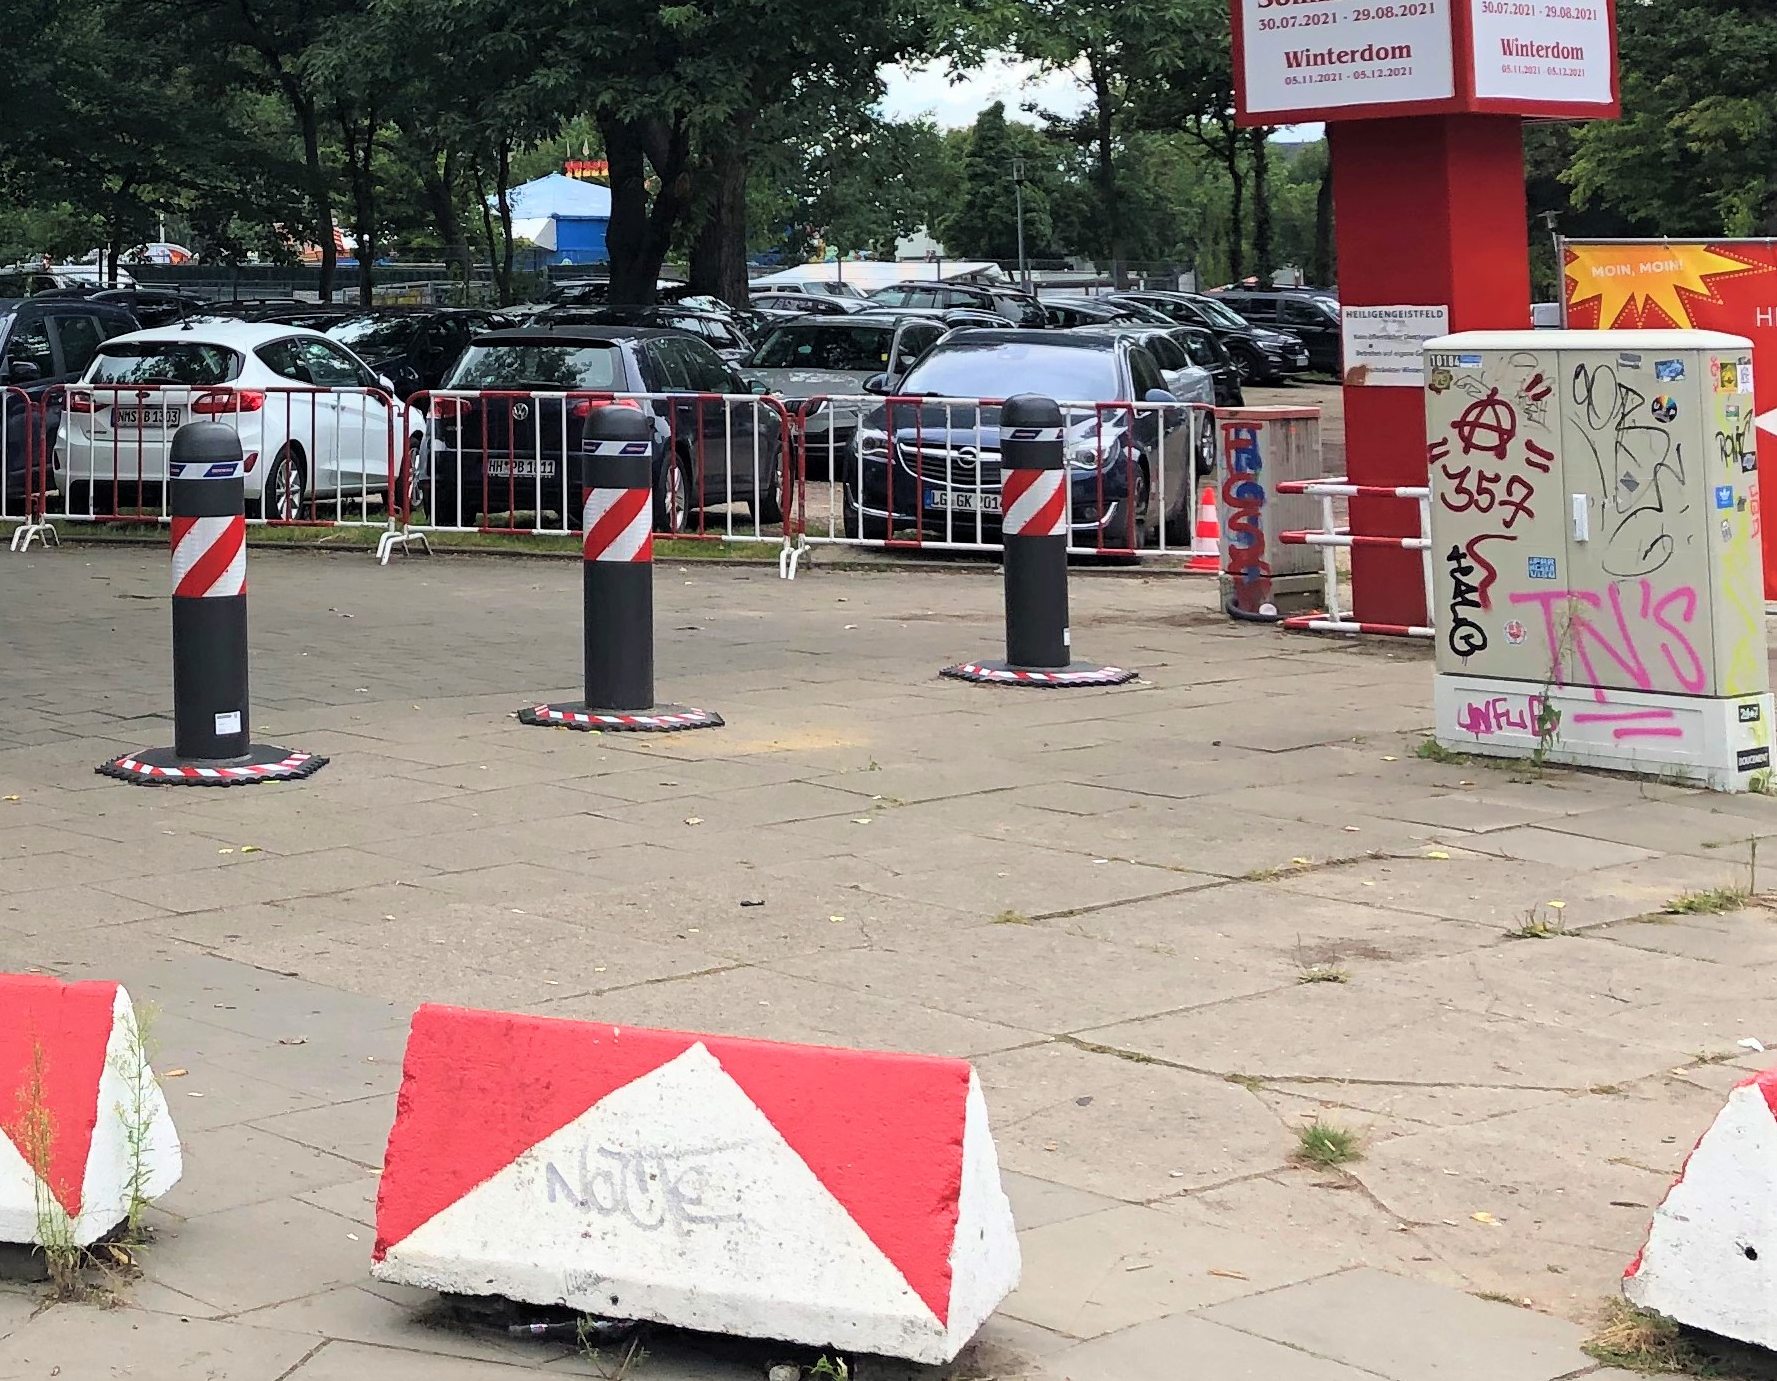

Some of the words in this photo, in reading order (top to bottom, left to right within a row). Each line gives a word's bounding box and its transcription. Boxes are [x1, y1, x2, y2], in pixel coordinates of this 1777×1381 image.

[1258, 11, 1337, 31] 30.07.2021
[1353, 2, 1435, 22] 29.08.2021
[1482, 1, 1535, 16] 30.07.2021
[1545, 6, 1597, 20] 29.08.2021
[1284, 44, 1412, 68] Winterdom
[1501, 38, 1584, 60] Winterdom
[1284, 72, 1342, 85] 05.11.2021
[1353, 66, 1412, 80] 05.12.2021
[1502, 65, 1540, 75] 05.11.2021
[1547, 67, 1585, 77] 05.12.2021
[1592, 262, 1635, 277] MOIN,
[1639, 260, 1683, 273] MOIN!
[1346, 310, 1443, 319] HEILIGENGEISTFELD
[1756, 306, 1777, 328] H
[489, 461, 502, 472] HH
[527, 461, 553, 473] 111
[956, 494, 972, 507] GK
[977, 496, 1002, 510] 01
[1441, 464, 1535, 529] 357
